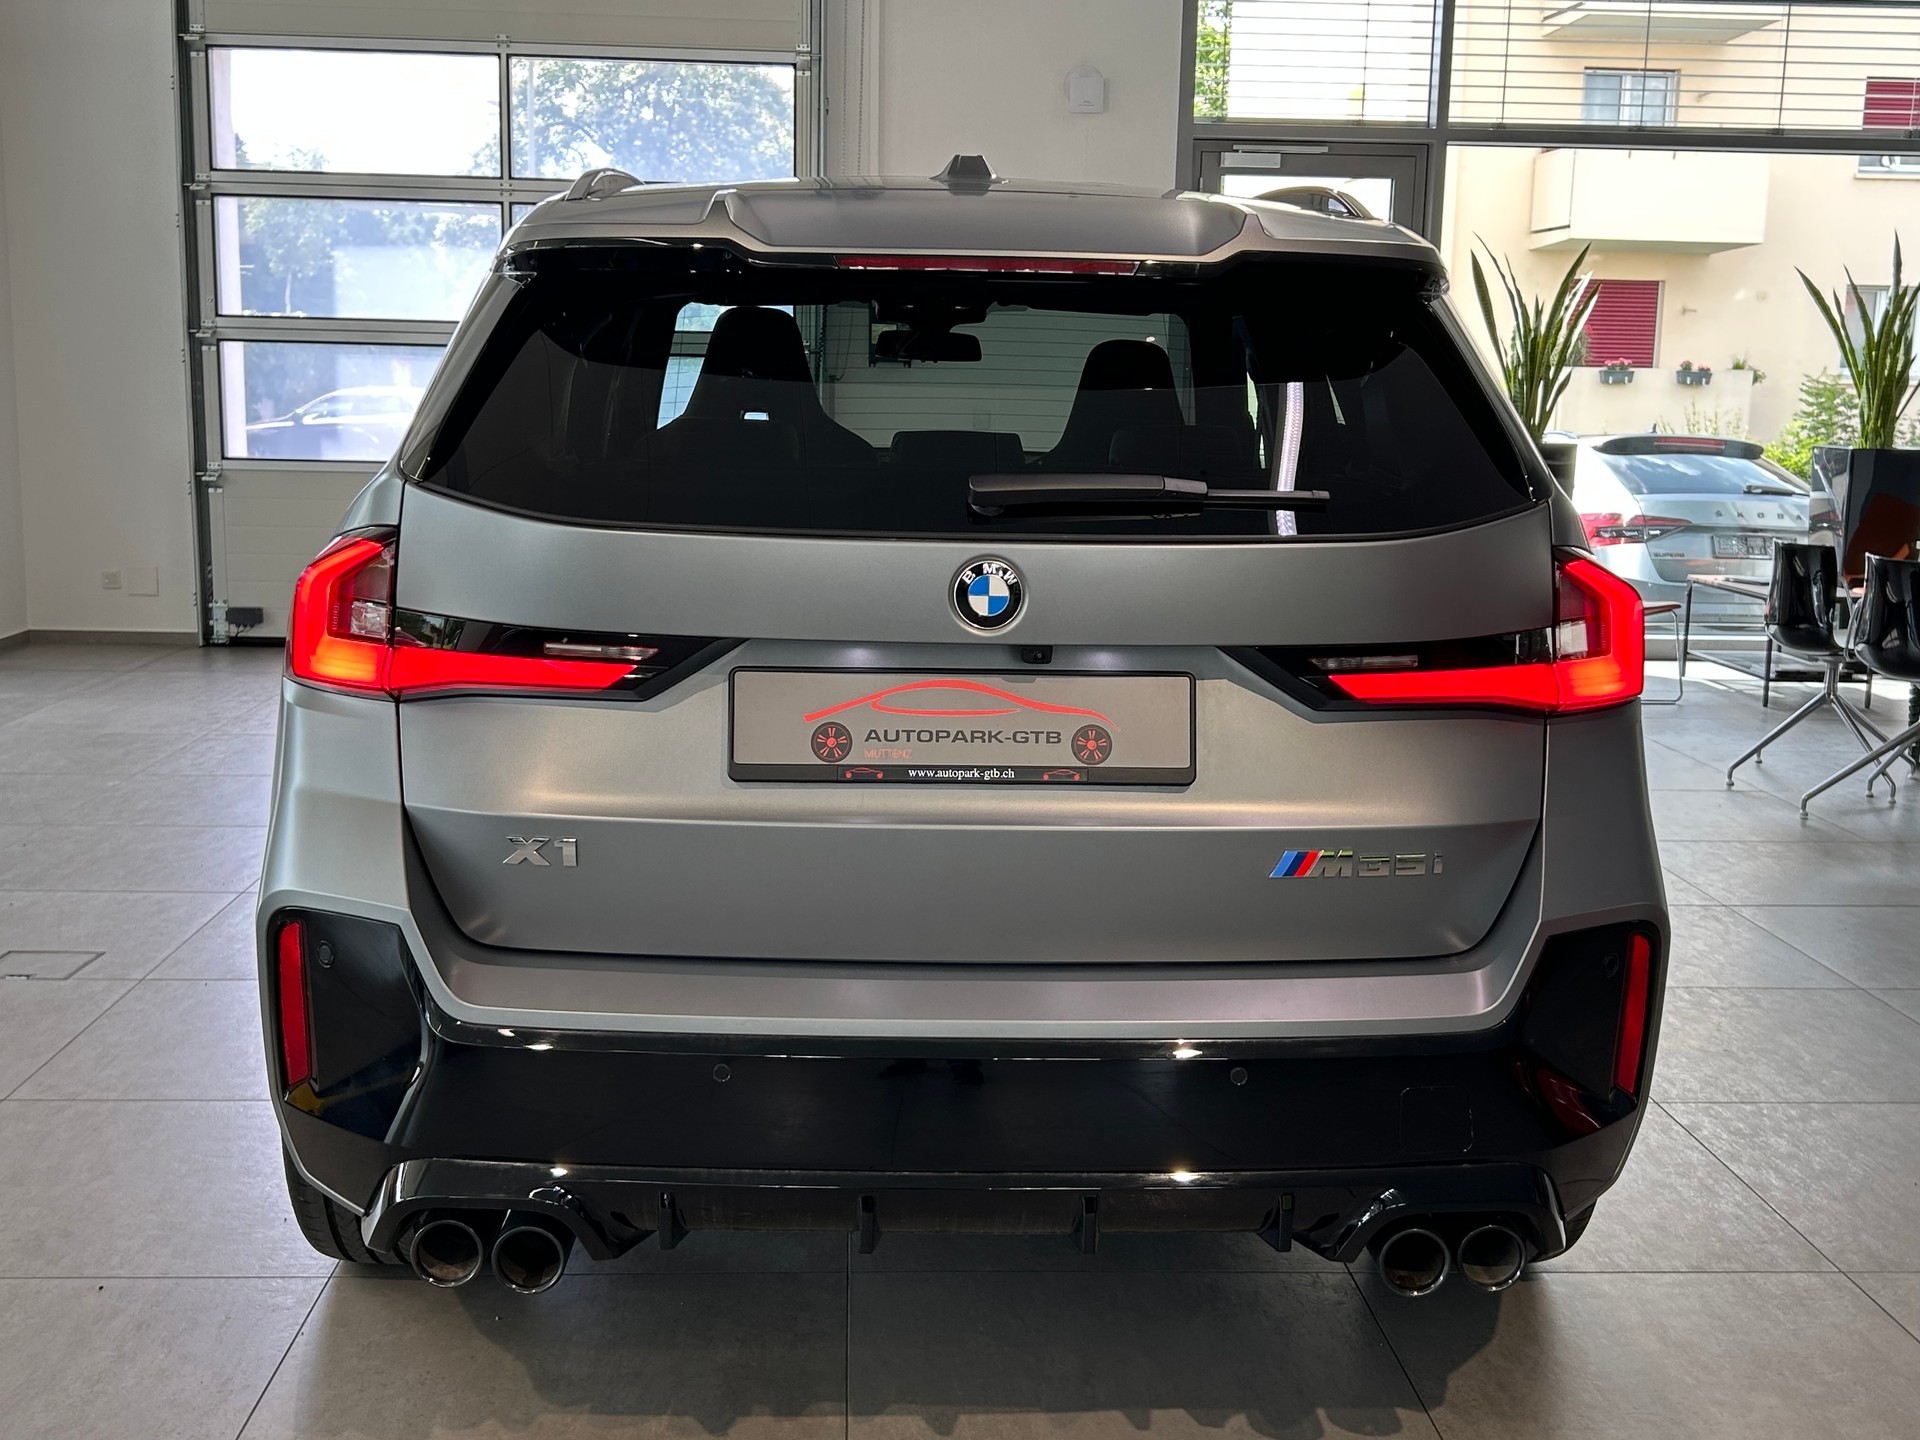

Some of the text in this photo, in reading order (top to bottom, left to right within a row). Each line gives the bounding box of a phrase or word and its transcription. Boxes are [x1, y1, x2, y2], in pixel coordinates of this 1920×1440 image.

[961, 562, 1018, 586] BMW
[864, 728, 1062, 745] AUTOPARK-GTB
[908, 768, 1015, 780] www.autopark-gtb.ch
[502, 836, 578, 867] X1
